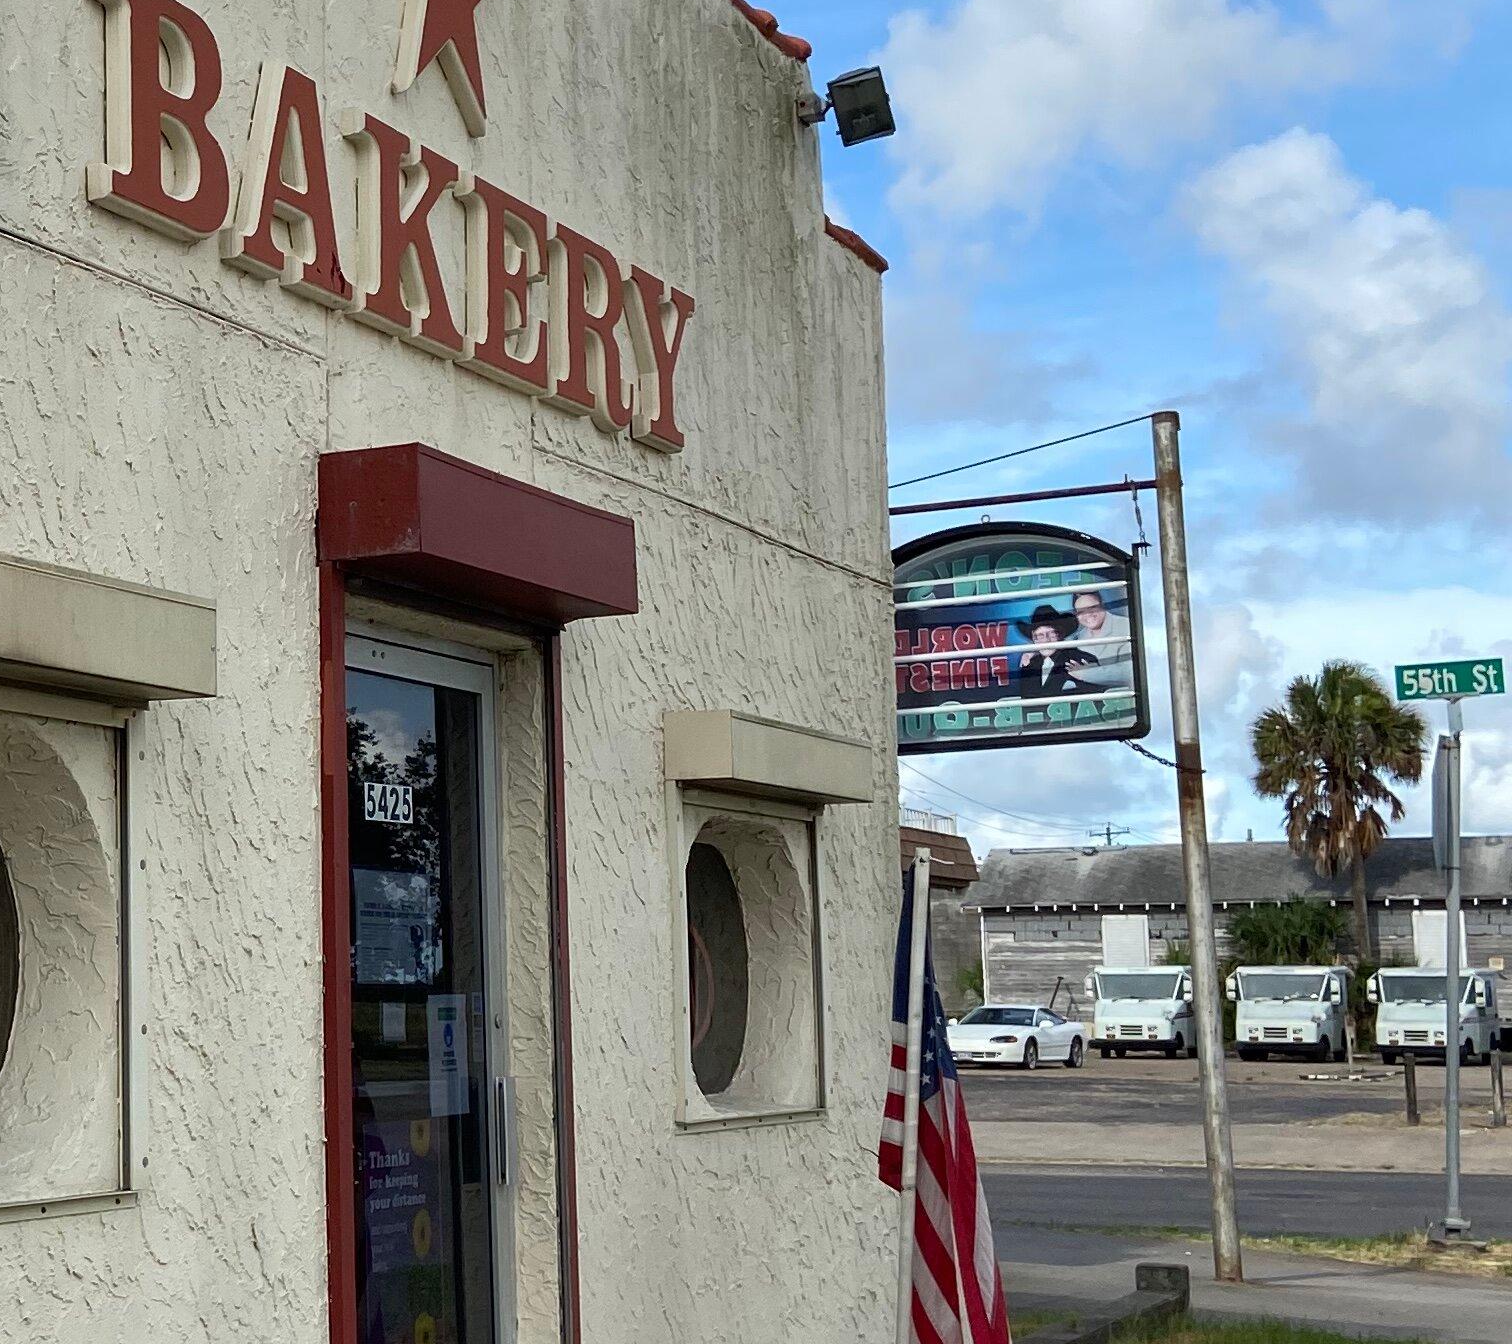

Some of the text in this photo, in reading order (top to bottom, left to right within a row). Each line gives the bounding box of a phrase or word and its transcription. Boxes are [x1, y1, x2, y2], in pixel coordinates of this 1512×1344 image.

[1402, 664, 1498, 696] 55th St
[367, 784, 411, 821] 5425
[369, 1149, 410, 1169] Thanks
